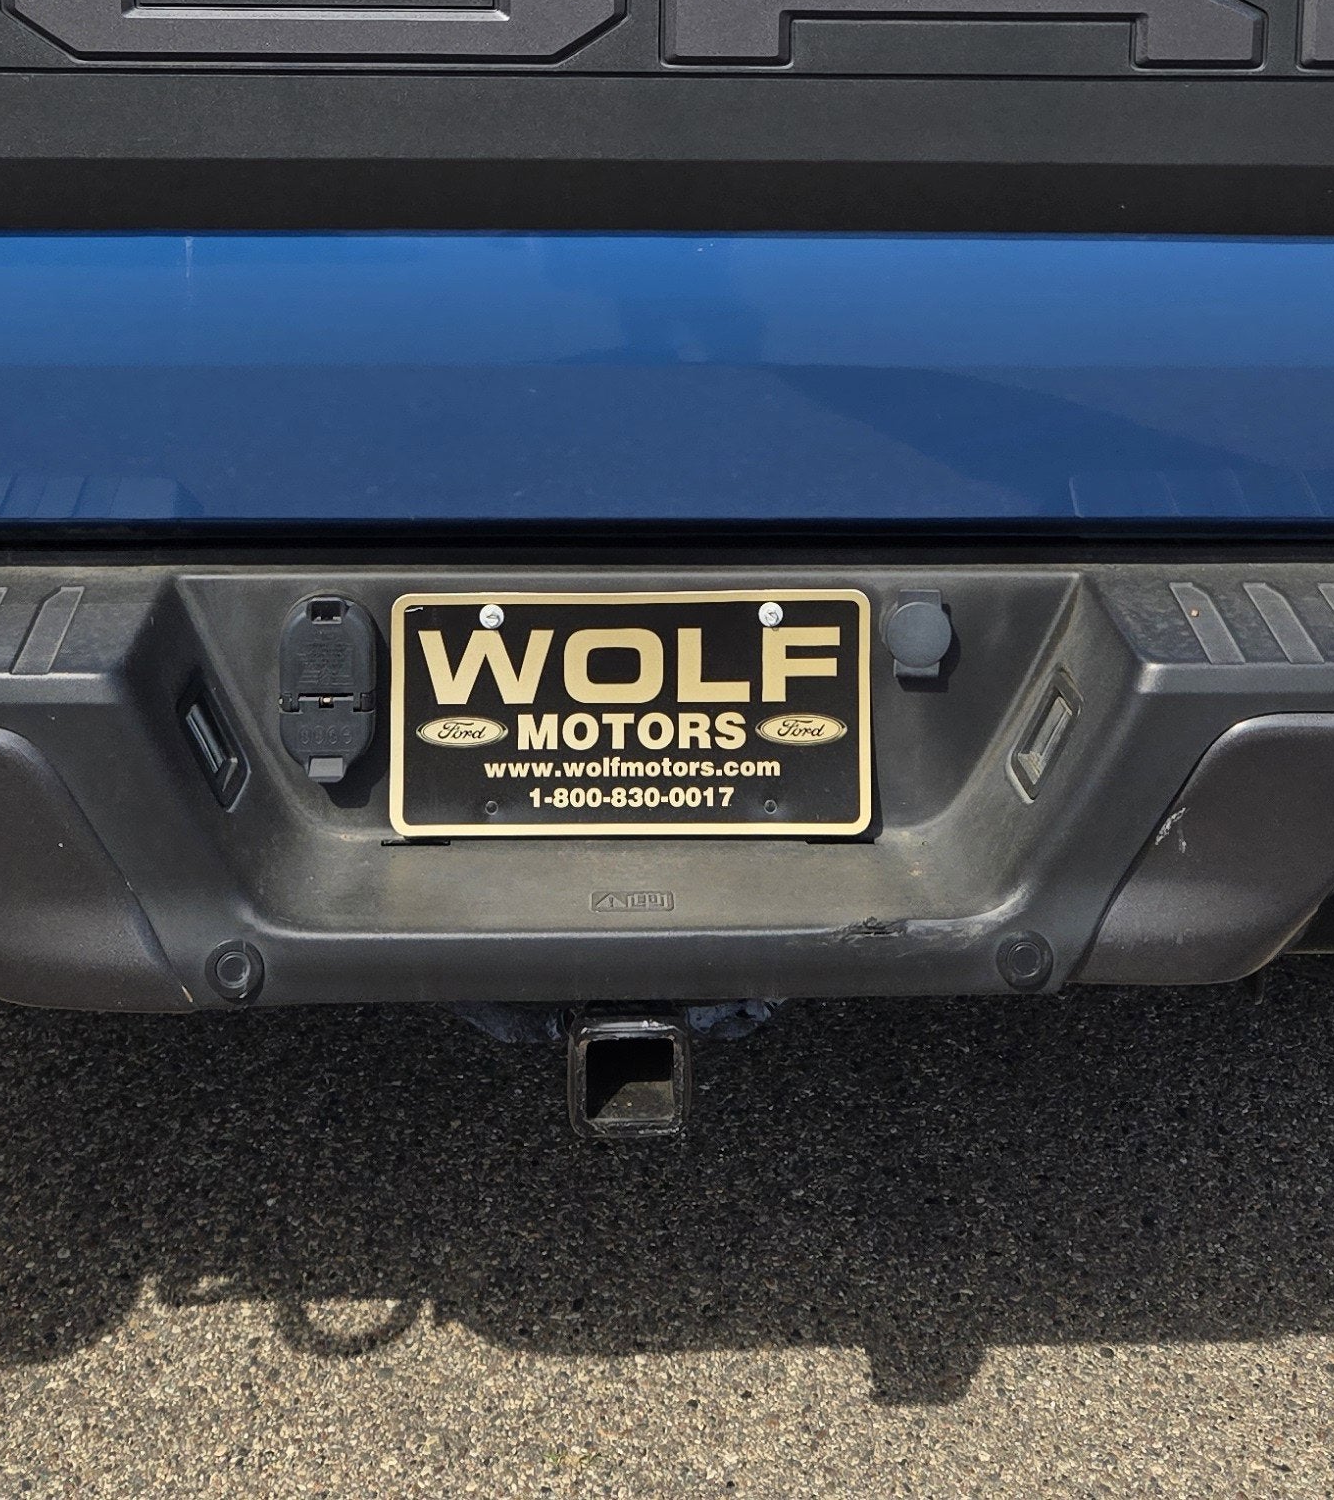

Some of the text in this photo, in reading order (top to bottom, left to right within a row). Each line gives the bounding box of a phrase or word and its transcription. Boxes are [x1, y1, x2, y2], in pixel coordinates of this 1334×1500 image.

[417, 626, 841, 705] WOLF
[437, 721, 487, 740] Ford
[517, 711, 747, 751] MOTORS
[777, 718, 826, 737] Ford
[483, 757, 781, 779] www.wolfmotors.com
[529, 786, 736, 809] 1-800-830-0017
